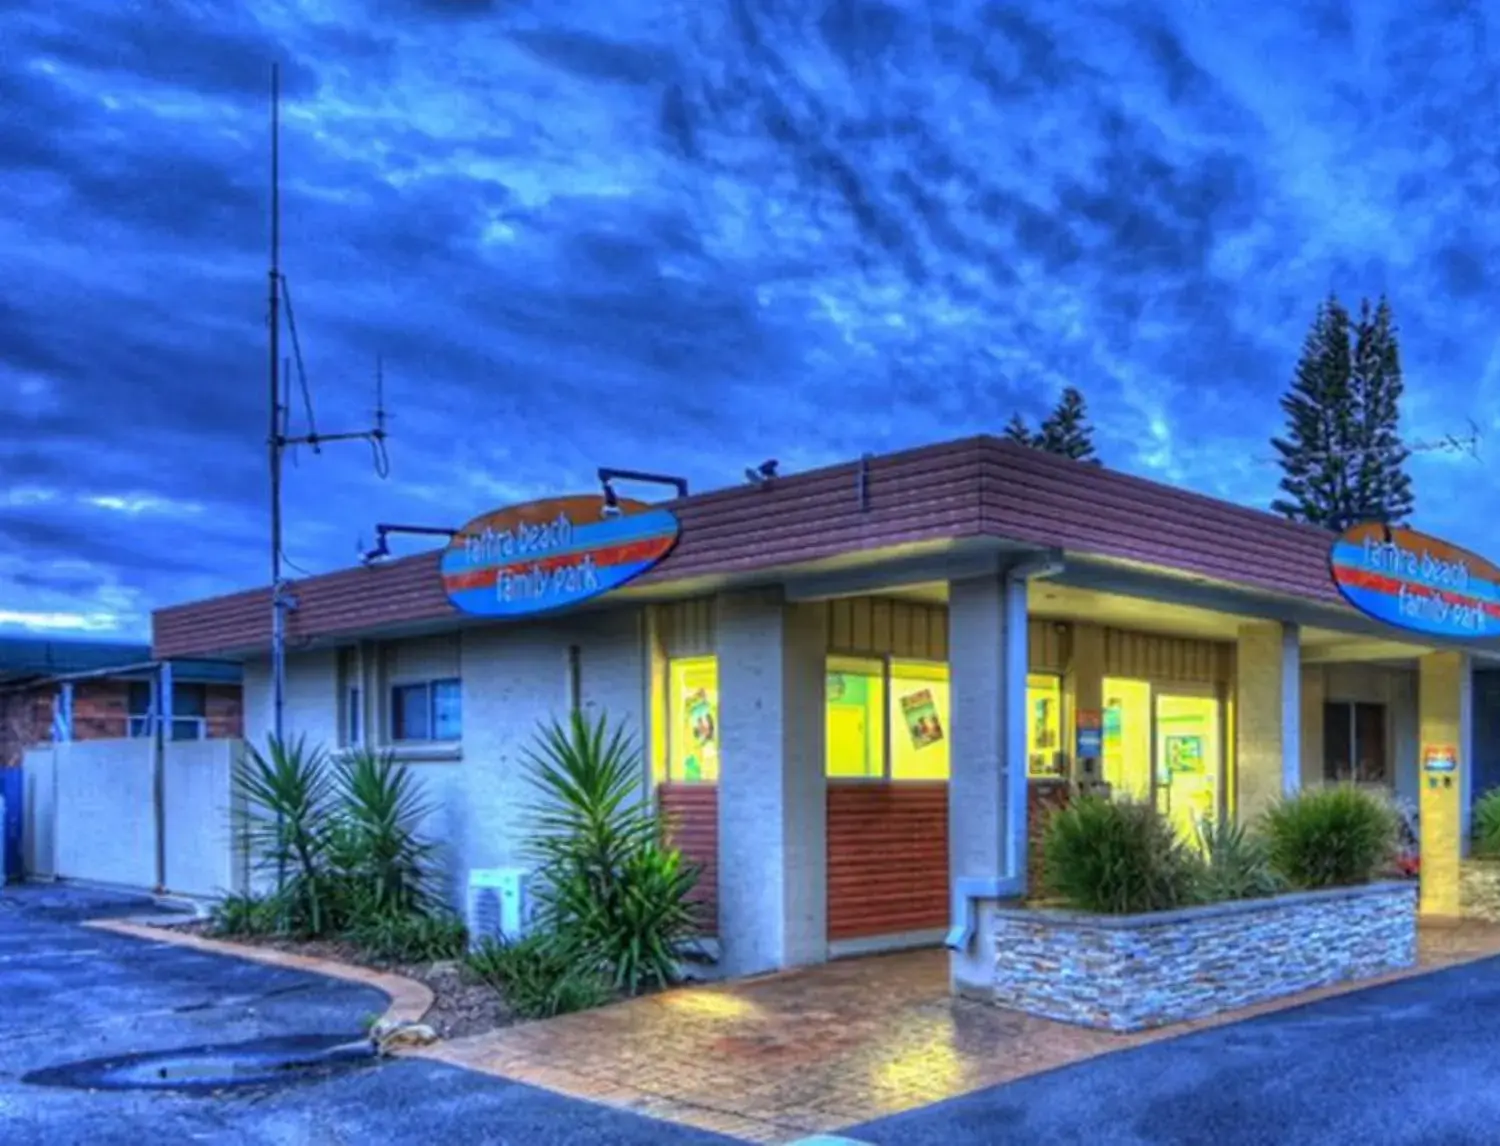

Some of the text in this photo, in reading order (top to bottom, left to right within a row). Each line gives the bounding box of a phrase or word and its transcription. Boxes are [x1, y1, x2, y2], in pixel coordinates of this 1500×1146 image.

[517, 511, 573, 555] beach
[496, 553, 598, 602] family park
[1421, 549, 1469, 591] beach
[1399, 582, 1487, 634] family park
